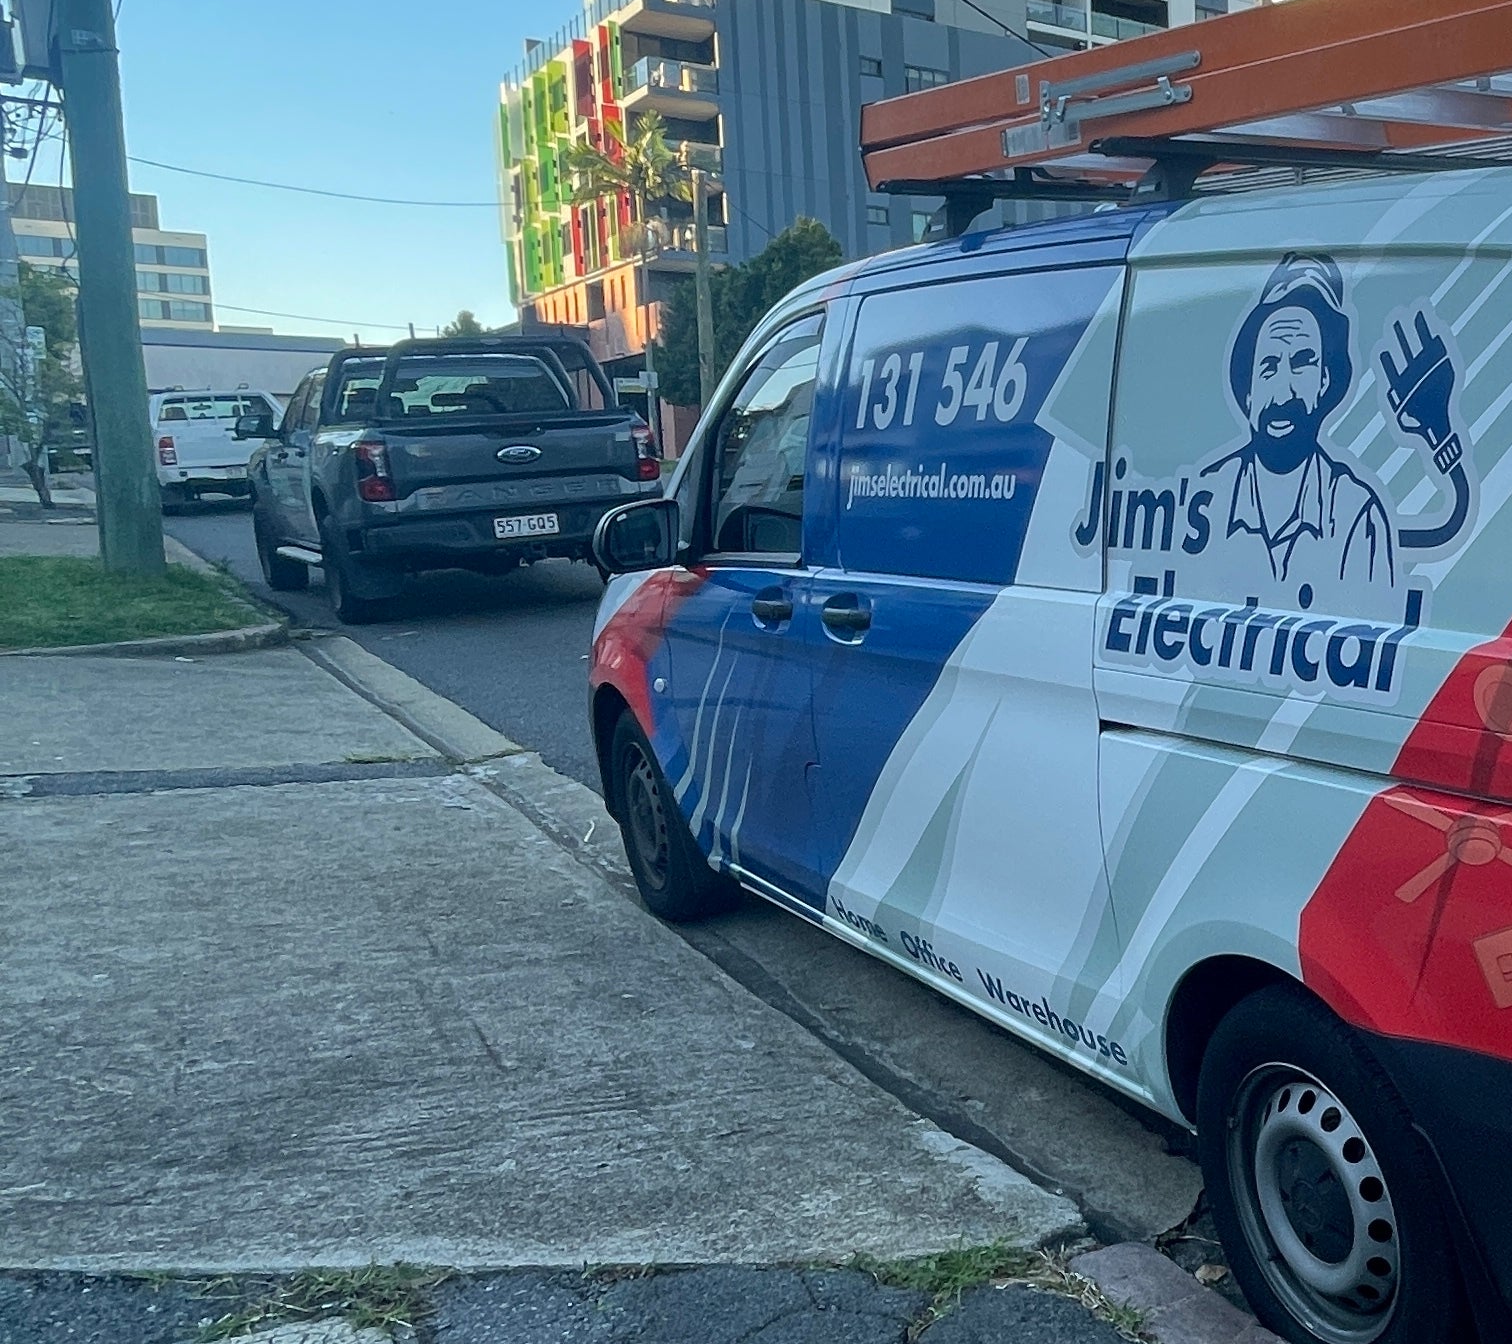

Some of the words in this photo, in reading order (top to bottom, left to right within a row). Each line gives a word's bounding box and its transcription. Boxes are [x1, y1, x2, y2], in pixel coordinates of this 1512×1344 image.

[856, 352, 922, 430] 131
[935, 337, 1028, 426] 546
[416, 479, 620, 510] RANGER
[496, 519, 522, 534] 557
[847, 462, 1016, 510] jimselectrical.com.au
[1075, 457, 1212, 553] Jim's
[1105, 569, 1422, 693] Electrical
[831, 896, 888, 943] Home
[900, 929, 963, 984] Office
[977, 967, 1129, 1066] Warehouse
